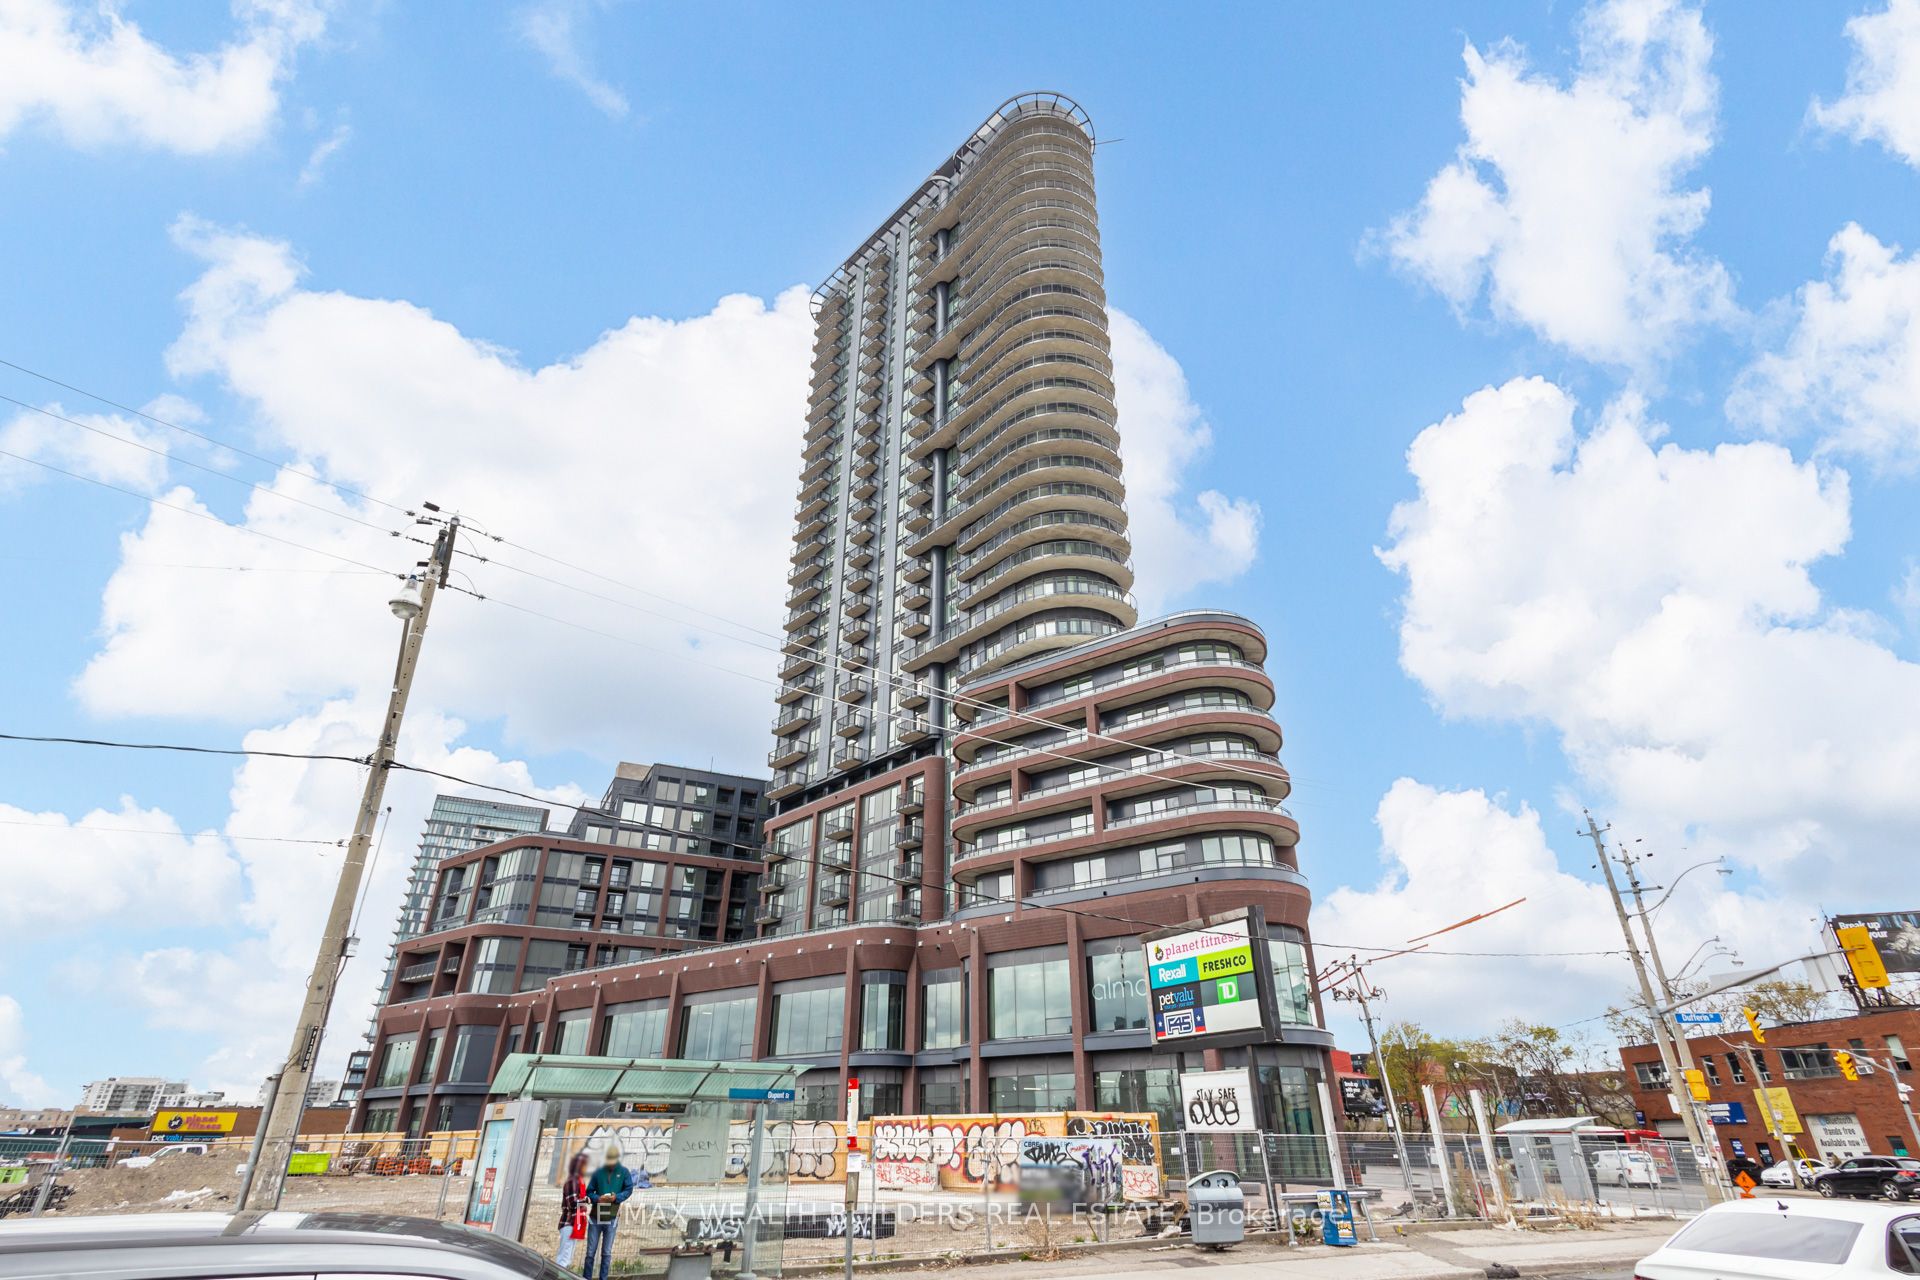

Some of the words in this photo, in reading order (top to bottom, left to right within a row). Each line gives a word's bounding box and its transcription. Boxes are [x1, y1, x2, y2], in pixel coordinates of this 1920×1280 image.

[1838, 921, 1866, 930] Break
[1867, 921, 1881, 930] up
[1165, 940, 1199, 959] planet
[1200, 931, 1241, 949] fitness
[1158, 964, 1187, 983] Rexall
[1218, 981, 1237, 999] TD
[1682, 1013, 1710, 1021] Dufferin
[1167, 1013, 1193, 1035] F45
[767, 1090, 784, 1099] Dupont
[1196, 1088, 1213, 1101] STAY
[1217, 1087, 1236, 1099] SAFE
[186, 1114, 219, 1123] planet
[187, 1121, 222, 1130] fitness
[1823, 1127, 1842, 1135] Hands
[1842, 1126, 1856, 1135] free
[1820, 1138, 1847, 1147] Available
